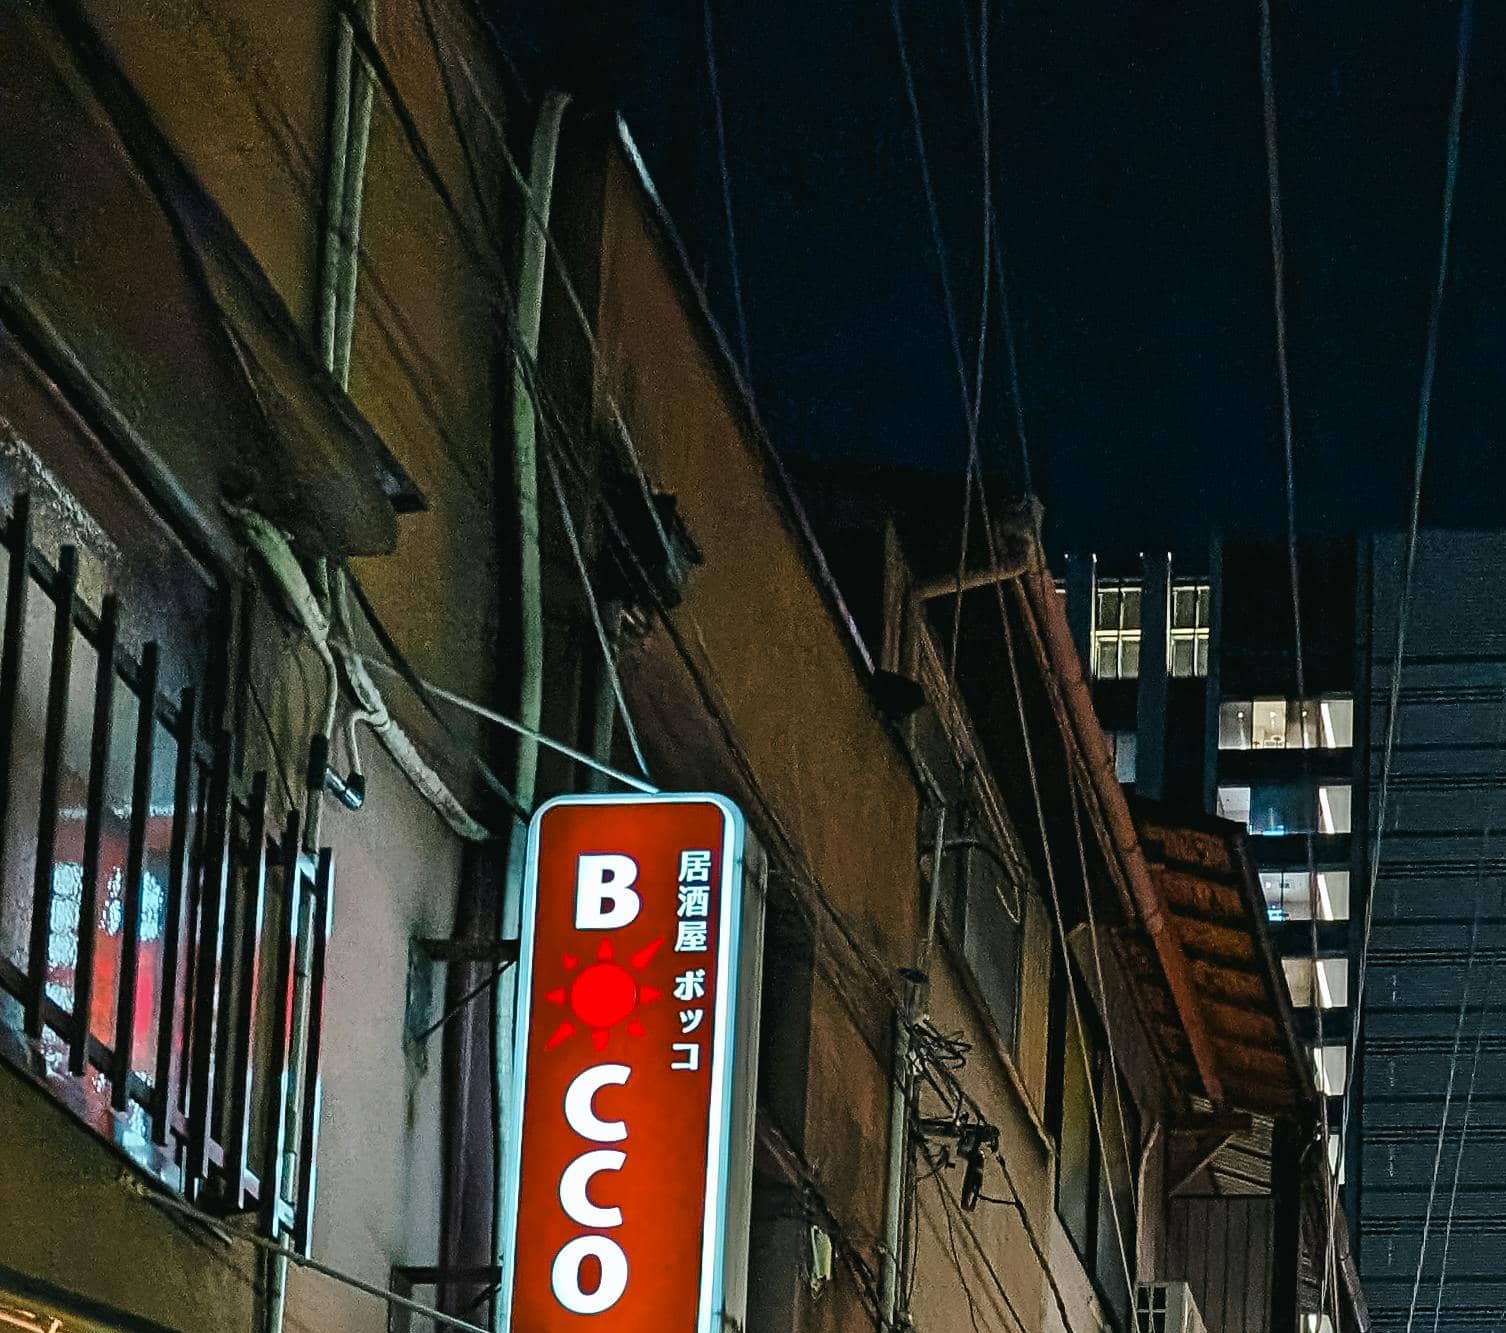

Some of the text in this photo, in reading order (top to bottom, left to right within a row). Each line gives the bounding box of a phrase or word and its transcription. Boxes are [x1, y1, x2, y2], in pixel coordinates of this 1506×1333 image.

[671, 850, 712, 1072] 居酒屋 ボッコ
